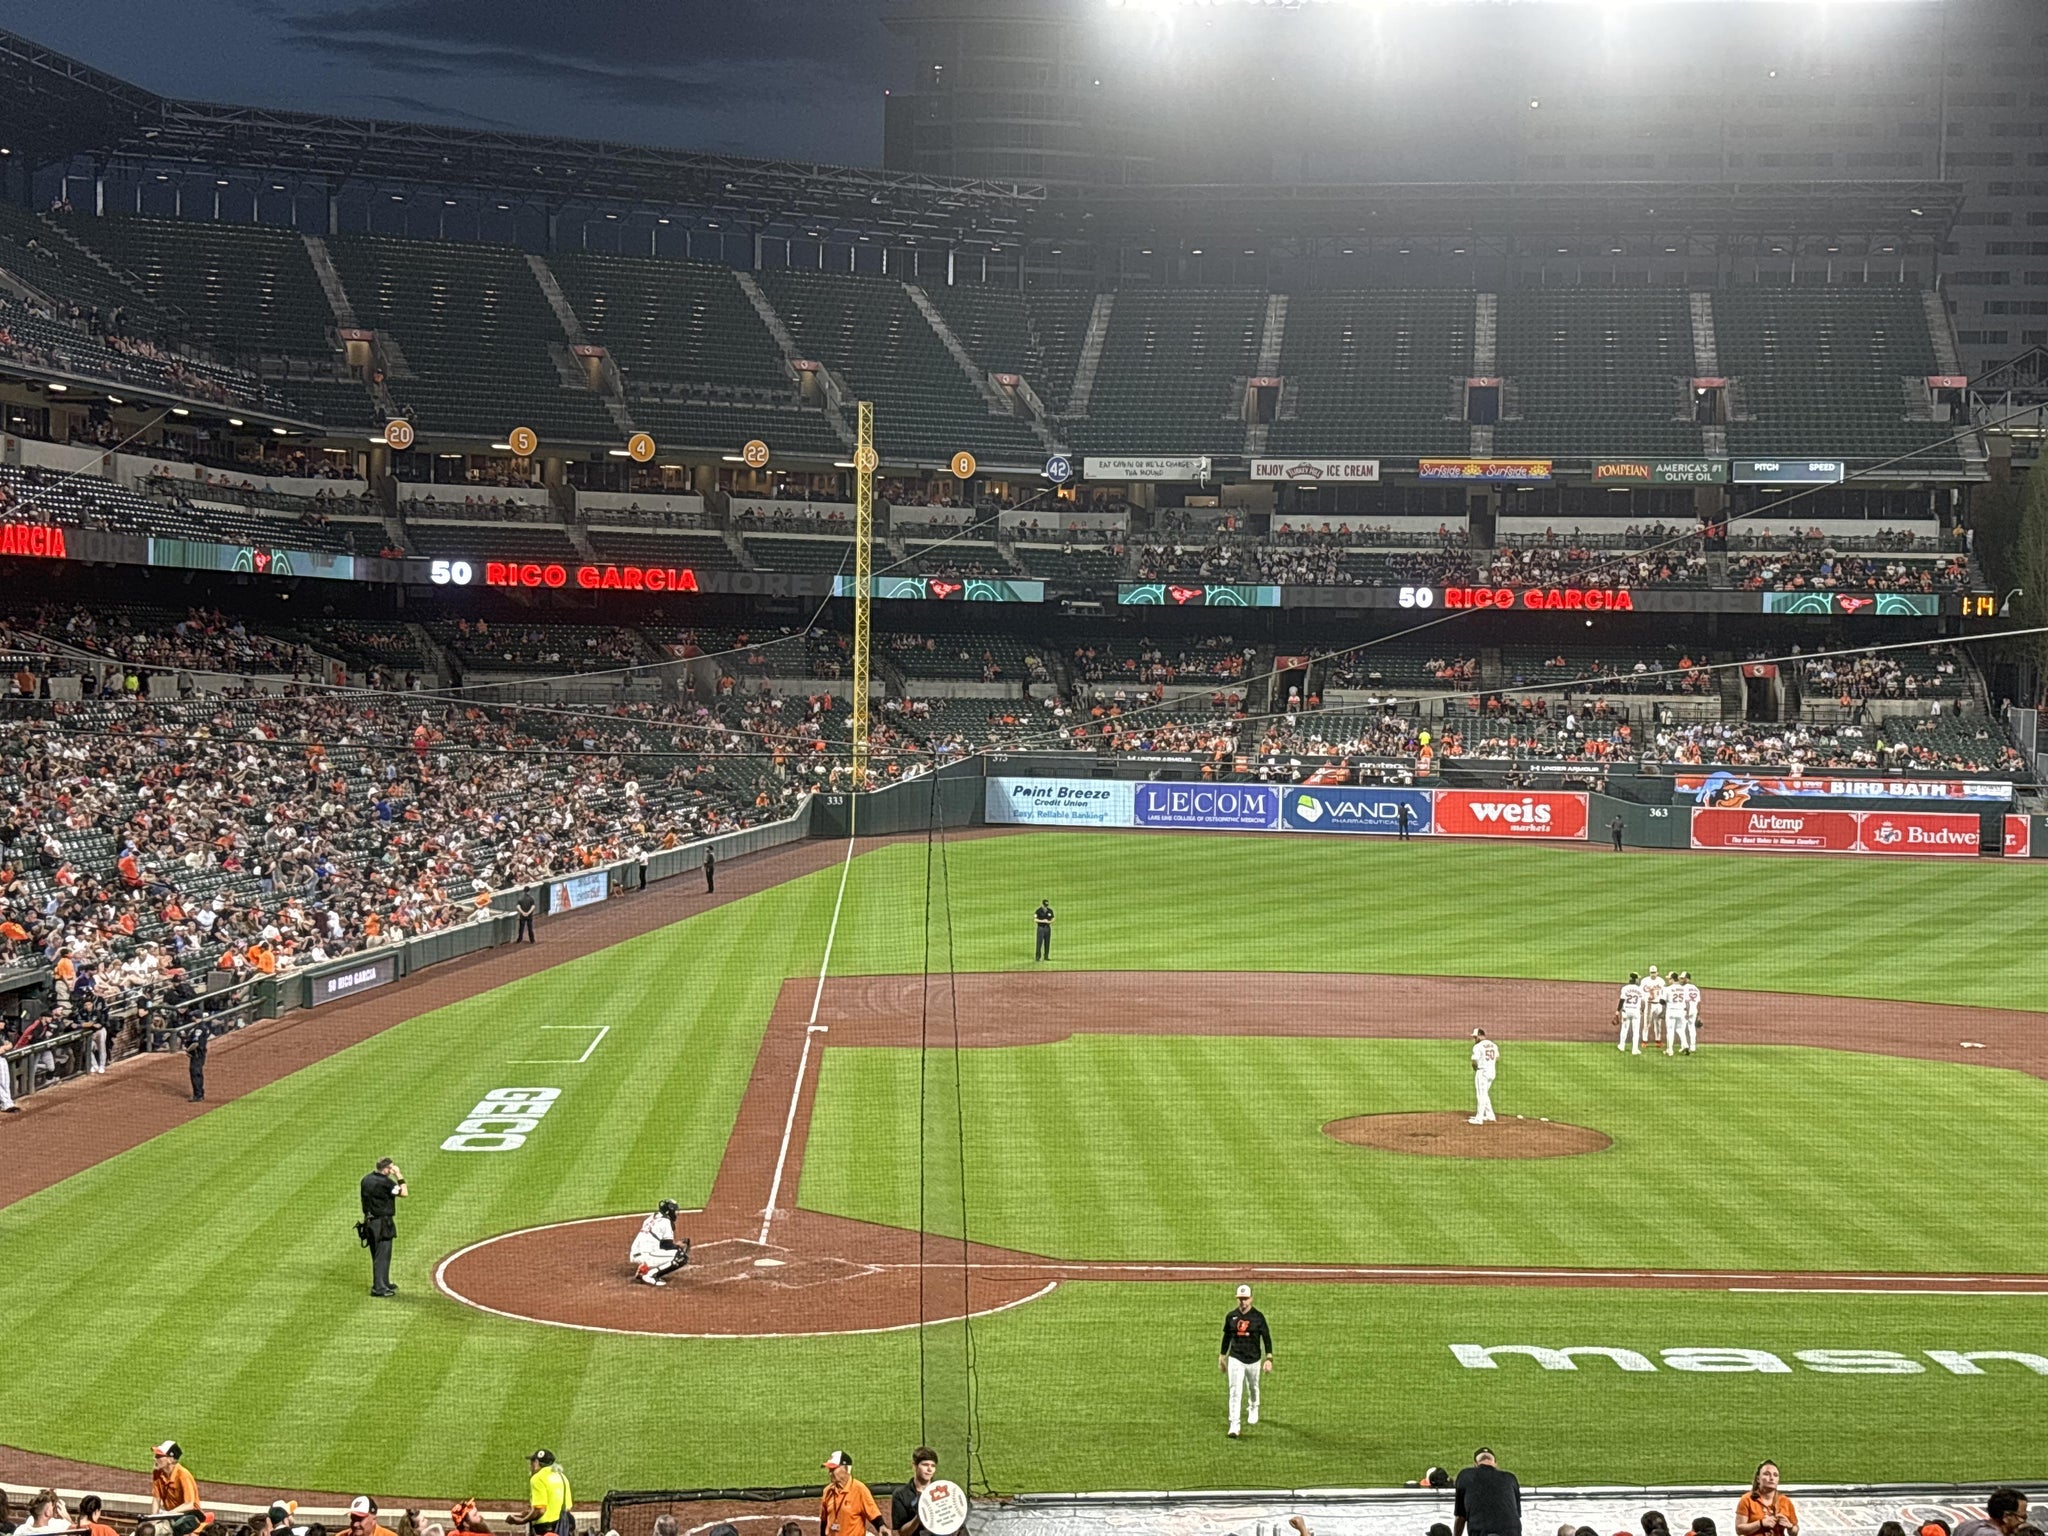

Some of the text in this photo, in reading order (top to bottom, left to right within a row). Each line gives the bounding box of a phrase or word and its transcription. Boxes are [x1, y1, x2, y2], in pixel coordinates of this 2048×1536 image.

[389, 426, 410, 443] 20
[517, 433, 528, 449] 5
[636, 440, 646, 455] 4
[747, 446, 766, 461] 22
[959, 459, 969, 472] 8
[1049, 462, 1066, 476] 42
[1256, 464, 1284, 476] ENJOY
[1326, 464, 1374, 477] ICE CREAM
[1420, 463, 1461, 477] Surfside
[1486, 463, 1527, 477] Surfside
[1598, 464, 1648, 478] POMPEIAN
[1655, 464, 1722, 472] AMERICA'S #1
[1754, 463, 1835, 472] PITCH SPEED
[1665, 473, 1712, 481] OLIVE OIL
[0, 523, 67, 558] ARCIA
[430, 560, 473, 585] 50
[486, 562, 567, 587] RICO
[576, 565, 699, 592] GARCIA
[1399, 587, 1433, 609] 50
[1444, 587, 1515, 610] RICO
[1523, 588, 1634, 611] GARCIA
[1962, 596, 1993, 616] 1:14
[1056, 786, 1111, 800] Breeze
[1830, 781, 1947, 797] BIRD BATH
[826, 796, 843, 806] 333
[1034, 798, 1088, 808] Credit Union
[1147, 791, 1267, 815] LECOM
[1013, 809, 1034, 820] Easy,
[1037, 810, 1070, 819] Reliable
[1325, 801, 1418, 819] VANDA
[1468, 797, 1552, 823] weis
[1649, 807, 1668, 817] 363
[1510, 823, 1550, 833] markets
[1747, 813, 1804, 833] Airtemp
[1625, 994, 1639, 1005] 23
[1672, 993, 1684, 1003] 25
[1485, 1049, 1495, 1061] 50
